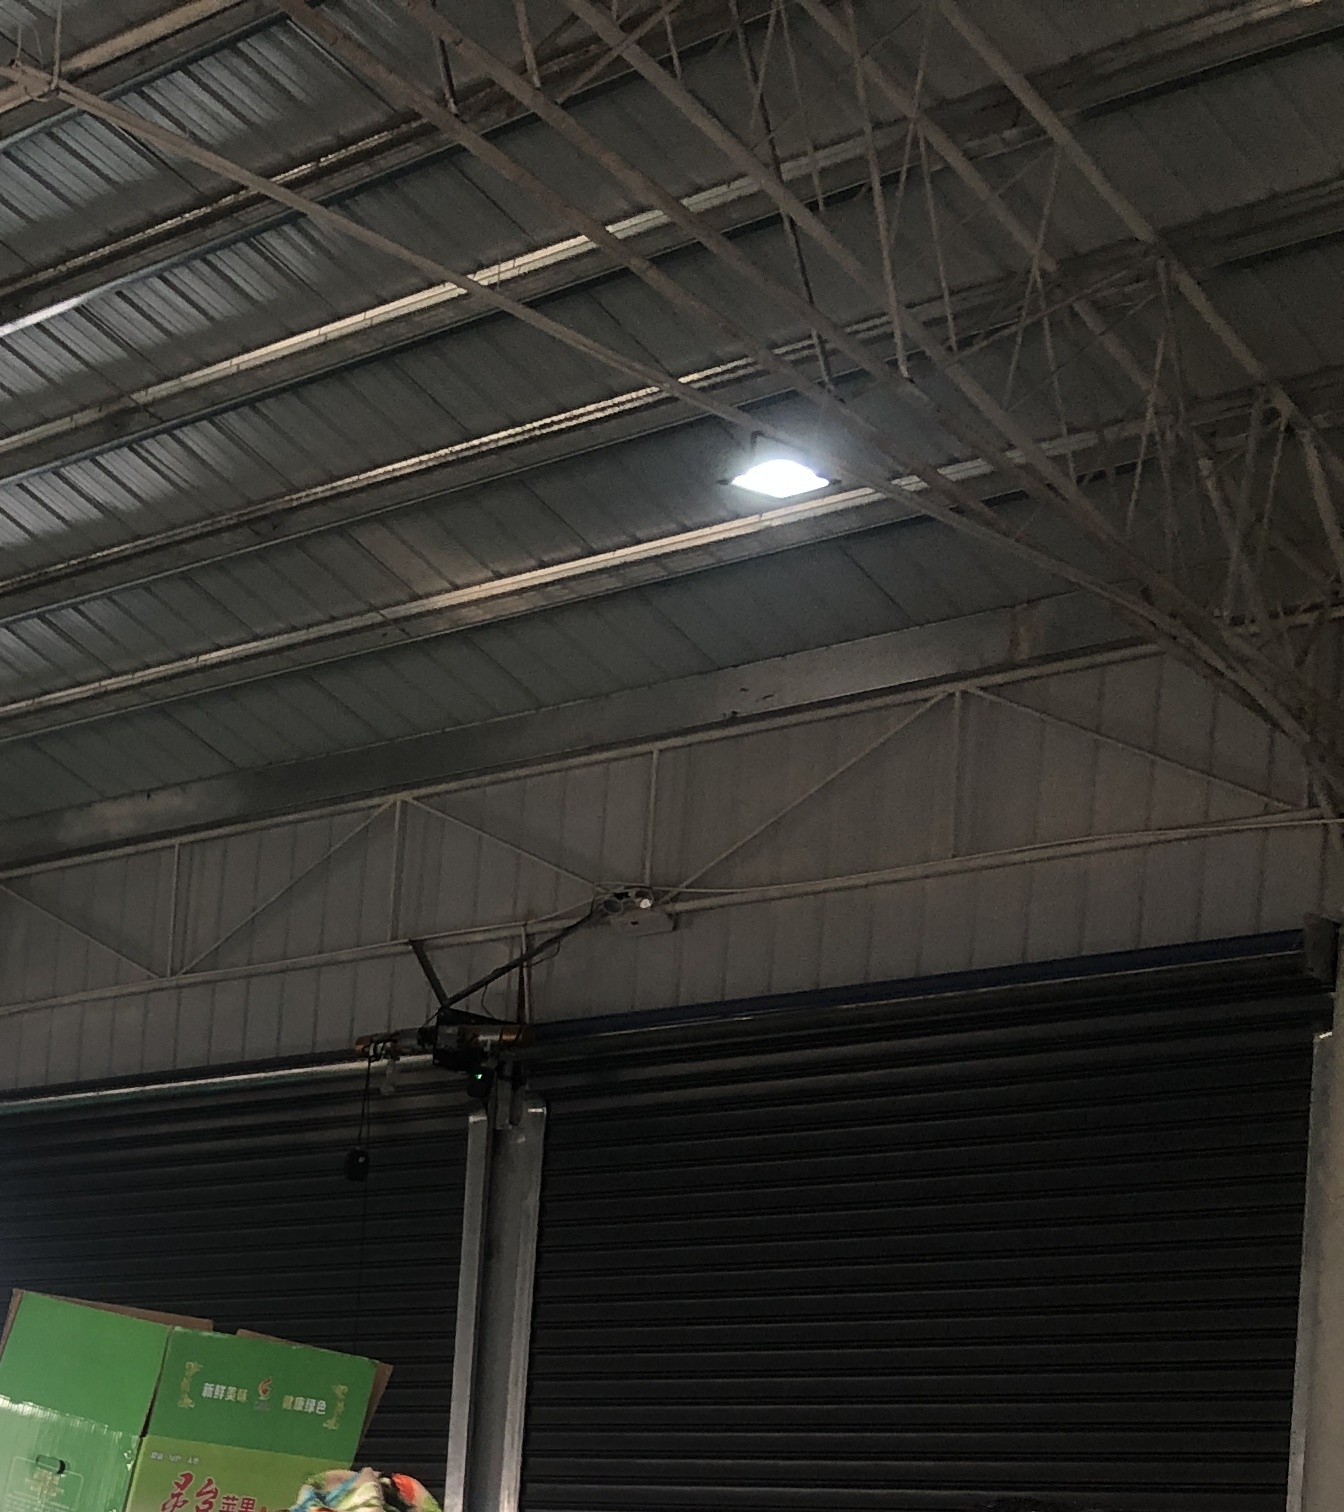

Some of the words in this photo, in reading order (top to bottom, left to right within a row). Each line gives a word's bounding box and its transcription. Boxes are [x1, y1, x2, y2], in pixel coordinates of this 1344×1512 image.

[201, 1382, 248, 1403] 新鲜美味
[282, 1395, 327, 1415] 健康绿色
